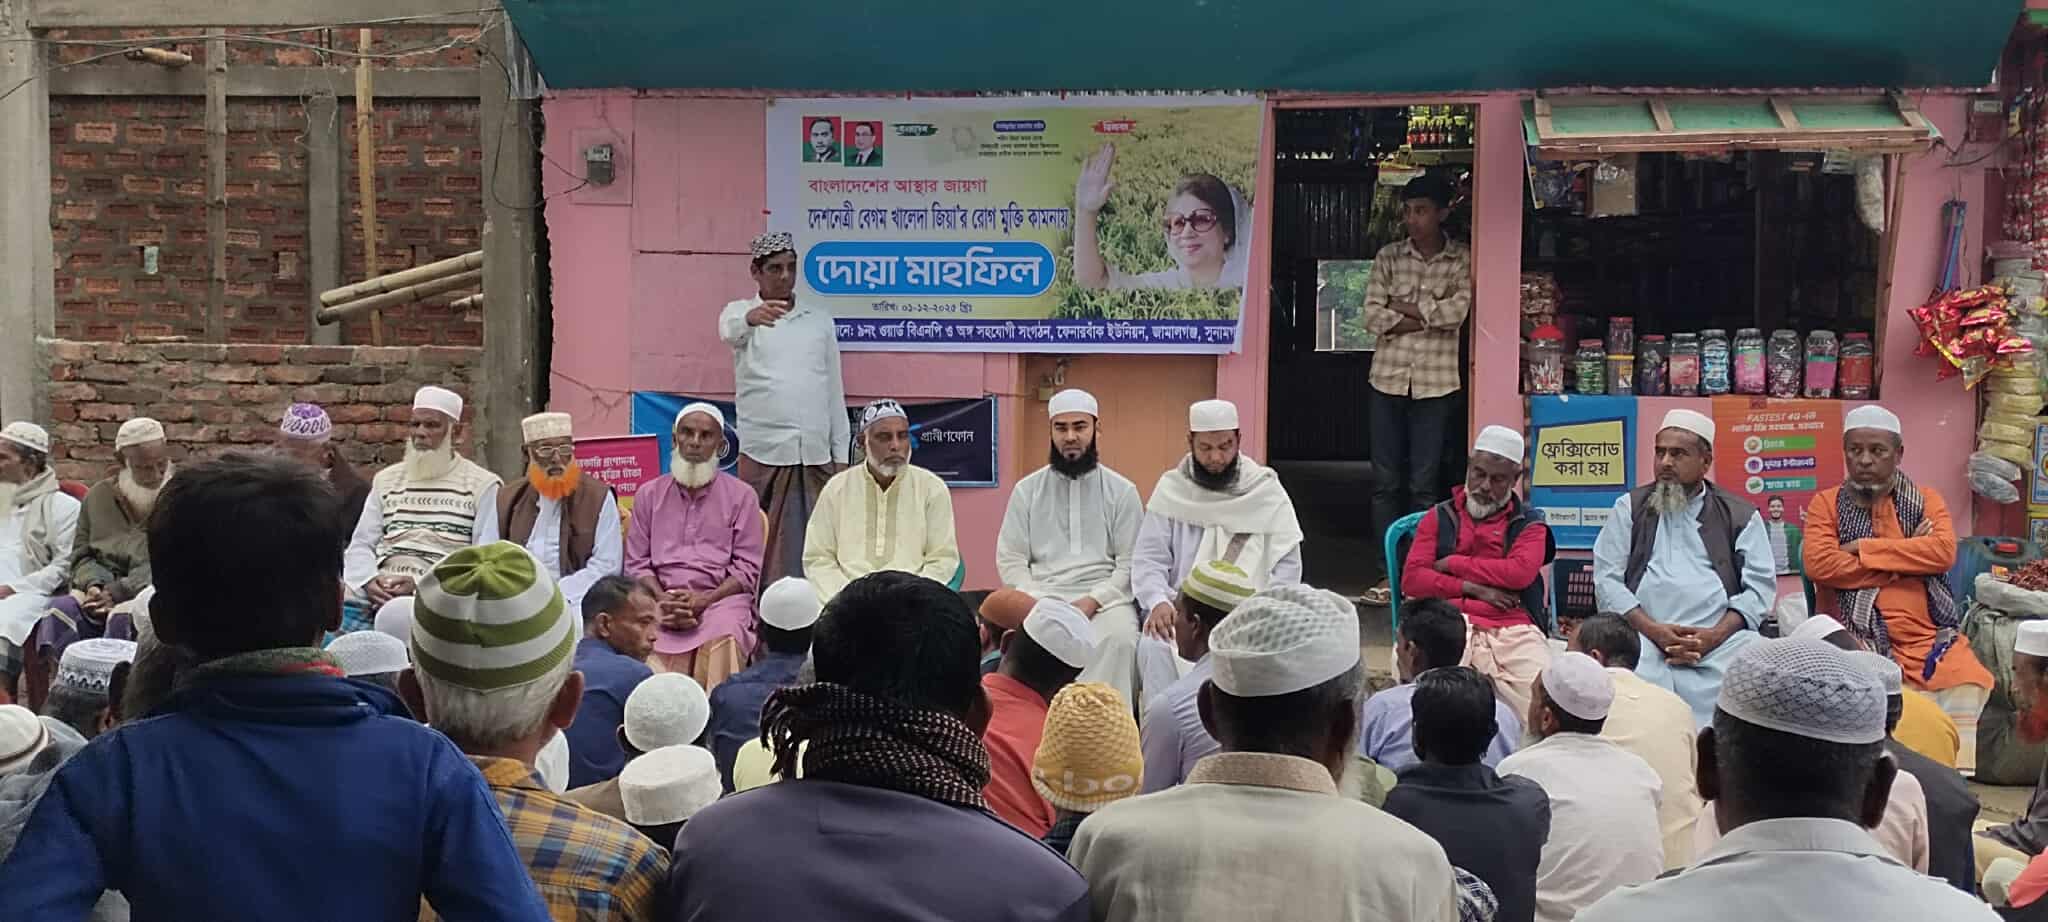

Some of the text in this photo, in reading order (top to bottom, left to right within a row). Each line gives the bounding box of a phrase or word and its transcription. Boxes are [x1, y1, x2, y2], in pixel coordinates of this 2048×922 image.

[808, 178, 988, 197] বাংলাদেশের আস্থার জায়গা
[807, 200, 855, 231] দেশনেত্রী
[858, 207, 888, 231] বেগম
[891, 207, 928, 231] খালেদা
[971, 207, 996, 231] রোগ
[1000, 201, 1024, 235] মুক্তি
[1027, 207, 1069, 231] কামনায়
[815, 246, 1044, 290] দোয়া মাহফিল
[902, 303, 957, 313] ০১-১২-২০২৫
[857, 324, 877, 339] ৯নং
[879, 320, 905, 338] ওয়ার্ড
[907, 321, 943, 338] বিএনপি
[945, 325, 953, 337] ও
[977, 321, 1016, 339] সহযোগী
[1018, 320, 1054, 340] সংগঠন,
[1107, 322, 1149, 341] ইউনিয়ন,
[1203, 325, 1237, 342] সুনামগ
[921, 428, 975, 443] গ্রামীণফোন
[1541, 438, 1620, 459] ফ্লেক্সিলোড
[1553, 461, 1610, 476] করা হয়
